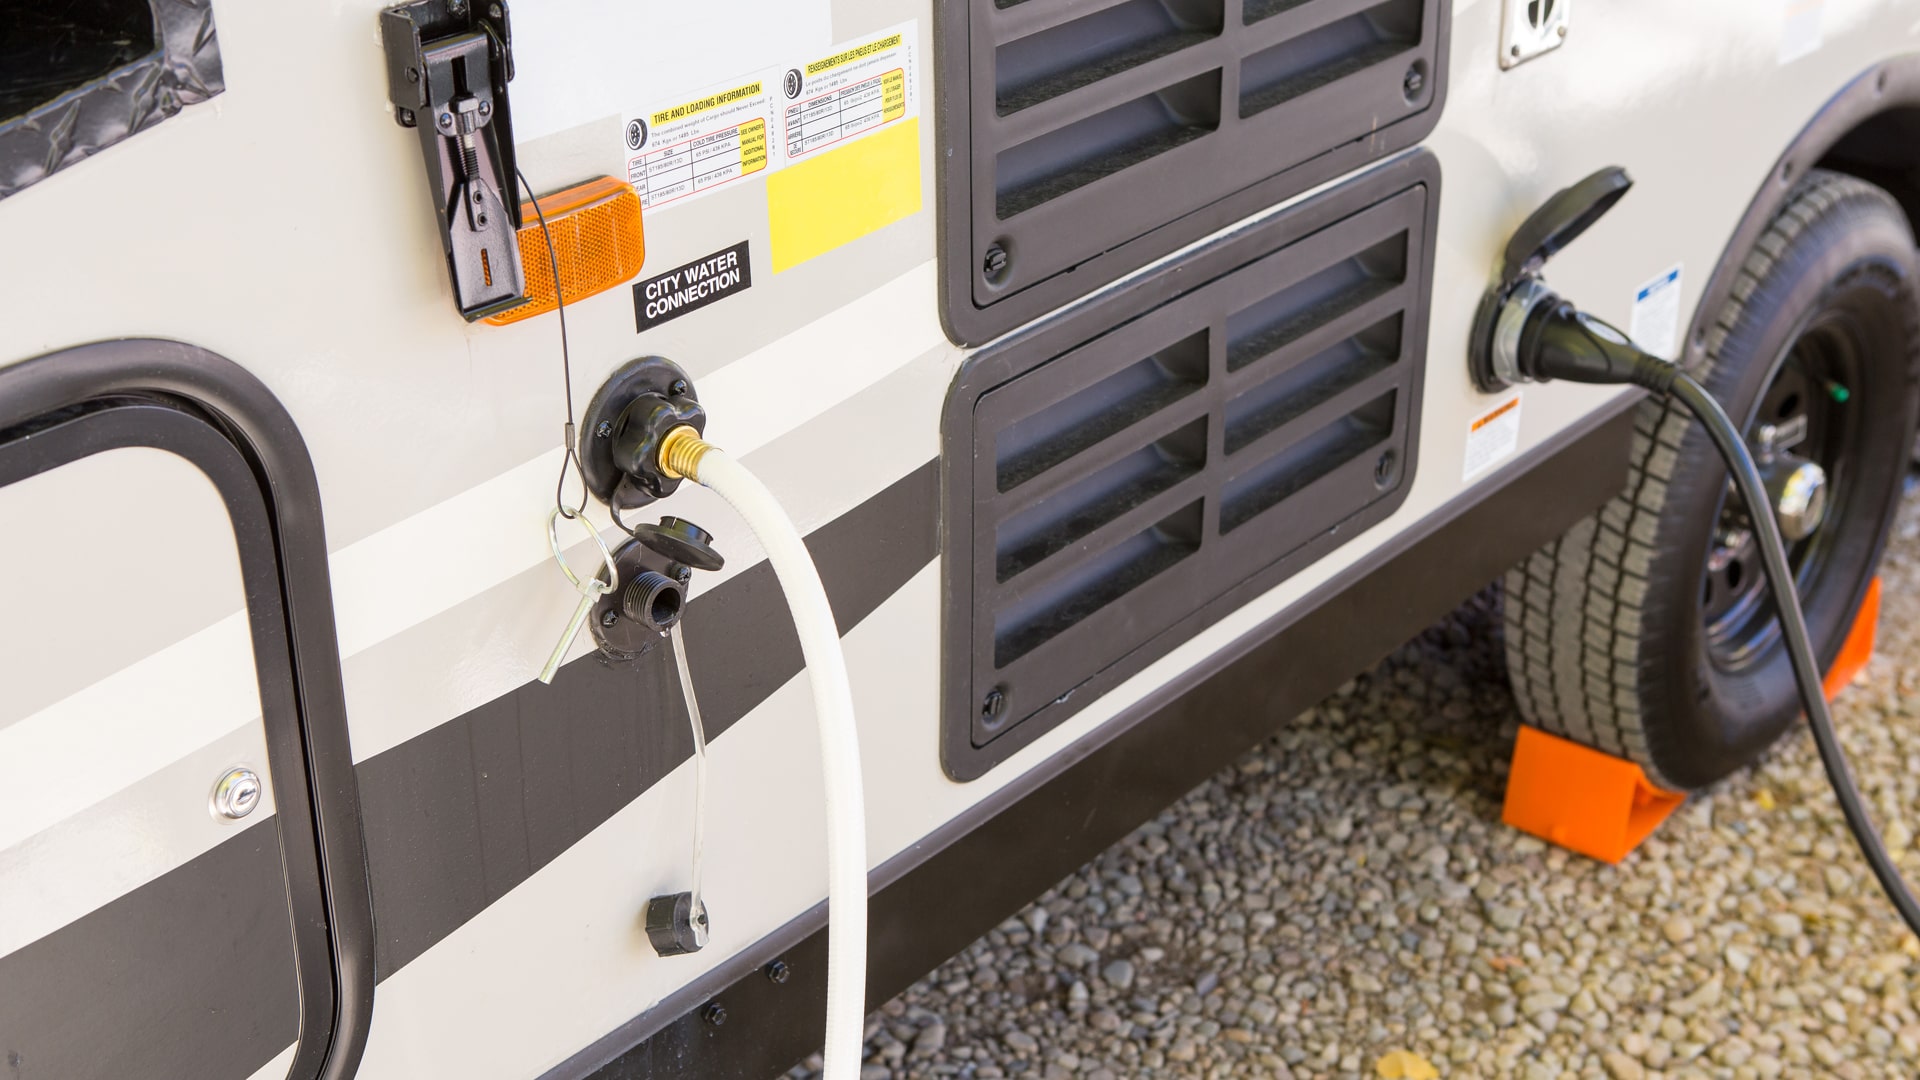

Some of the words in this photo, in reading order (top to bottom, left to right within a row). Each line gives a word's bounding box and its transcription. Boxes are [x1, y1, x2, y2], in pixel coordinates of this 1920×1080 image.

[654, 111, 669, 124] TIRE
[670, 107, 685, 119] AND
[686, 97, 715, 114] LOADING
[716, 83, 760, 105] INFORMATION
[808, 95, 832, 108] DIMENSIONS
[693, 138, 705, 147] COLD
[706, 135, 715, 143] TIRE
[716, 128, 738, 141] PRESSURE
[664, 149, 673, 157] SIZE
[631, 170, 646, 180] FRONT
[646, 273, 681, 300] CITY
[684, 251, 737, 284] WATER
[646, 268, 740, 319] CONNECTION
